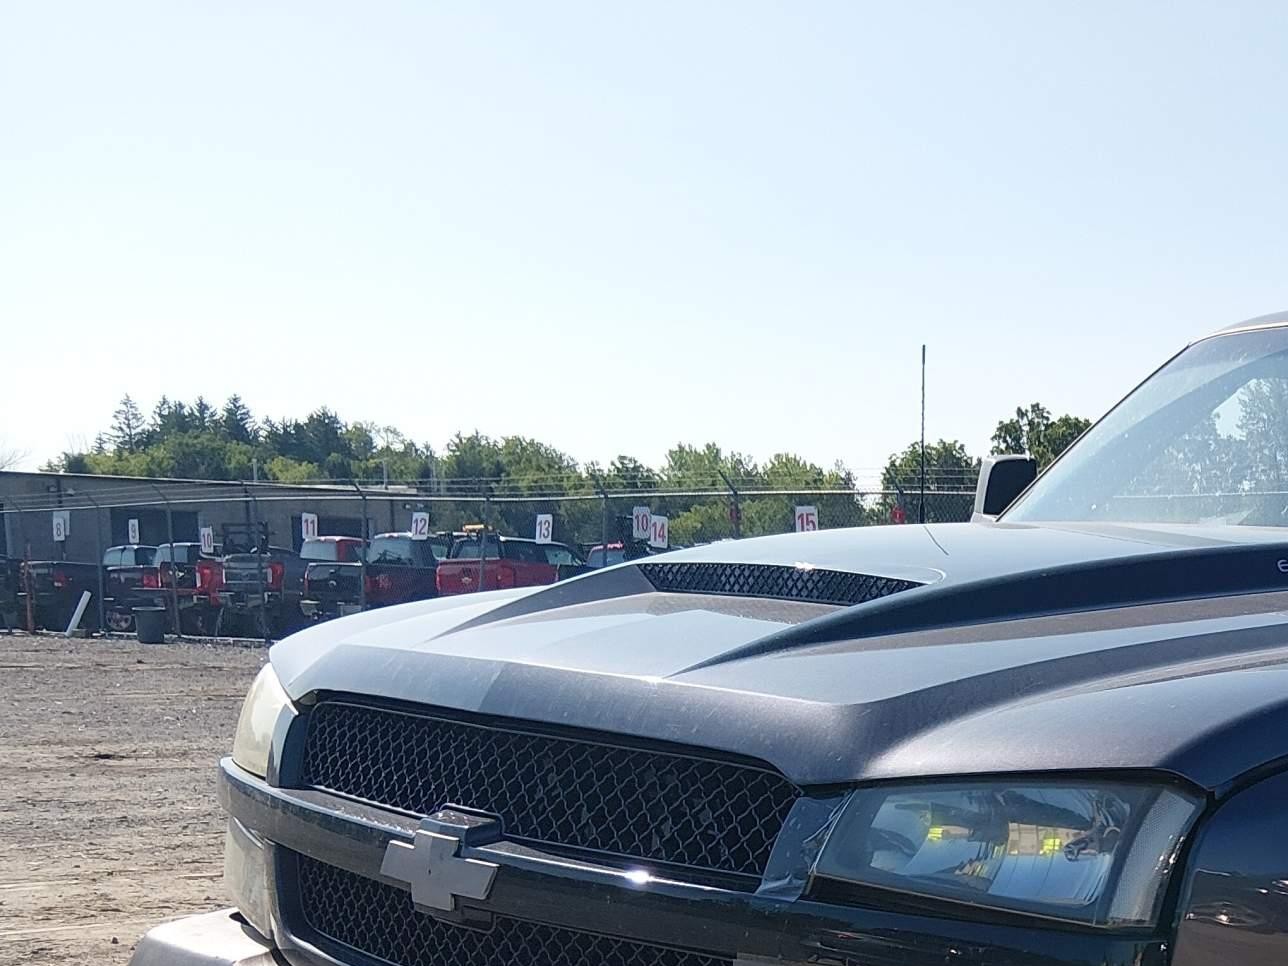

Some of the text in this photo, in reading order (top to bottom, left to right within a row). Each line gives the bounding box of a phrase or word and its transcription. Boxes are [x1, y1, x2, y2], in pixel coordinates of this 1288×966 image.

[55, 523, 62, 537] 8
[303, 518, 316, 536] 11
[413, 518, 427, 536] 12
[537, 519, 550, 539] 13
[634, 512, 649, 532] 10
[797, 512, 817, 532] 15
[130, 526, 137, 540] 9
[202, 533, 212, 549] 10
[651, 522, 666, 543] 14
